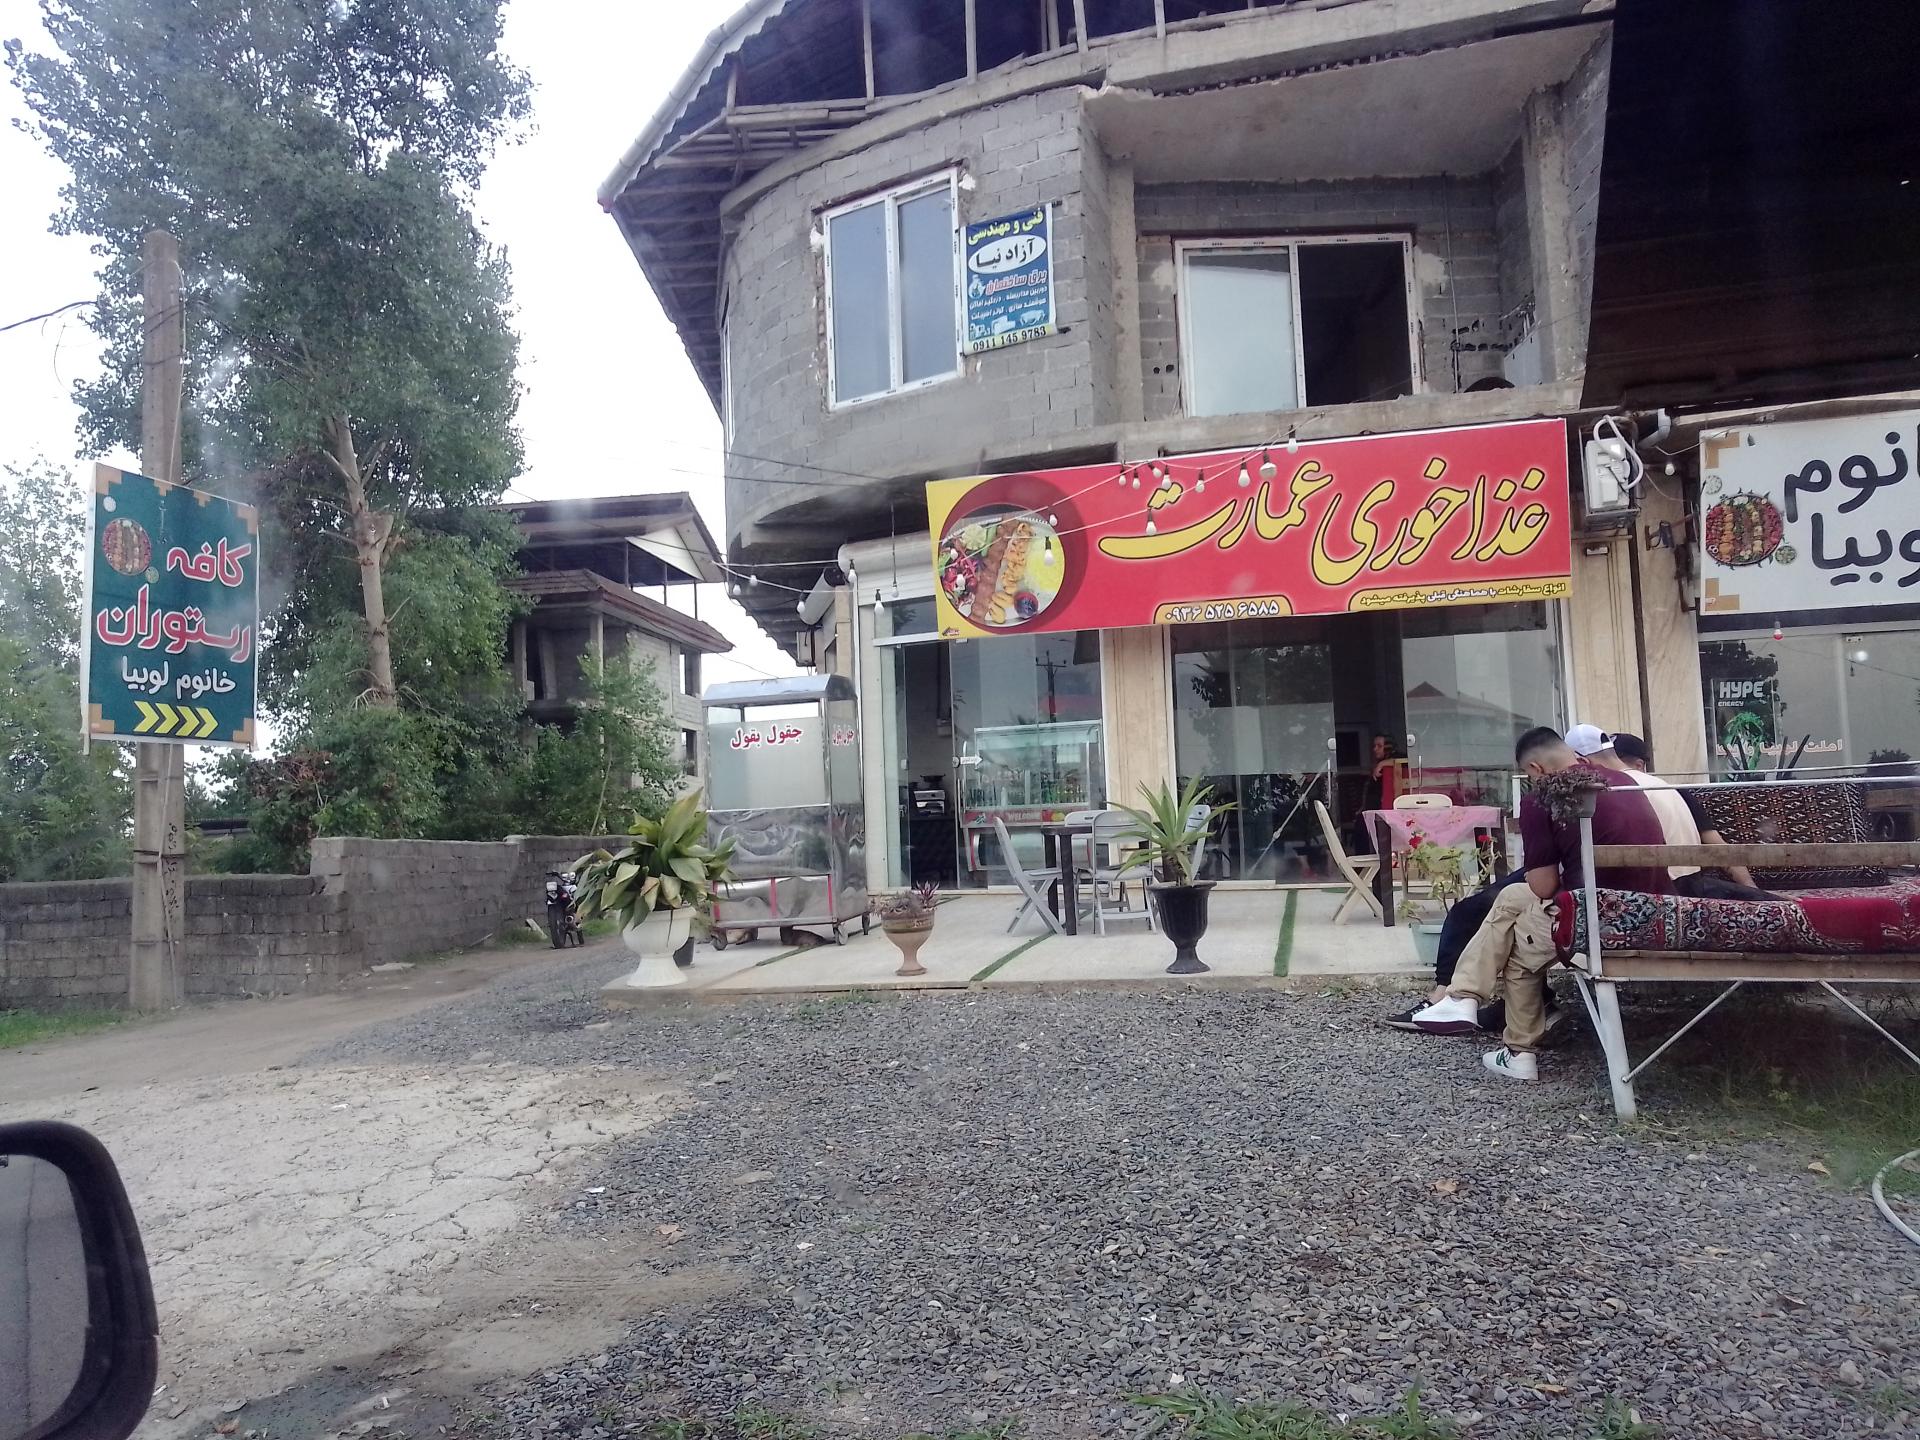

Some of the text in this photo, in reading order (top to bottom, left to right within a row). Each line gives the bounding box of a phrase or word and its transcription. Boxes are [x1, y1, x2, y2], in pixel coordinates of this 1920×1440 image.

[968, 207, 1044, 245] فنی و مهندسی
[976, 238, 1035, 269] آزاد نیا
[985, 269, 1047, 296] برق ساختمان
[973, 325, 1046, 352] 0911 145 9783
[1784, 424, 1920, 523] نوم
[1099, 459, 1334, 560] عمارت
[166, 537, 251, 587] کافه
[1360, 583, 1566, 606] انواع سفارشات با هماهنگی قبلی پذیرفته میشود
[97, 583, 251, 663] رستوران
[1165, 599, 1279, 622] ۰۹۳۶ ۵۲۵ ۶۵۸۵
[122, 655, 236, 699] خانوم لوبیا
[1720, 681, 1764, 698] HYPE
[731, 725, 803, 749] جقول بقول
[1803, 739, 1843, 753] املت
